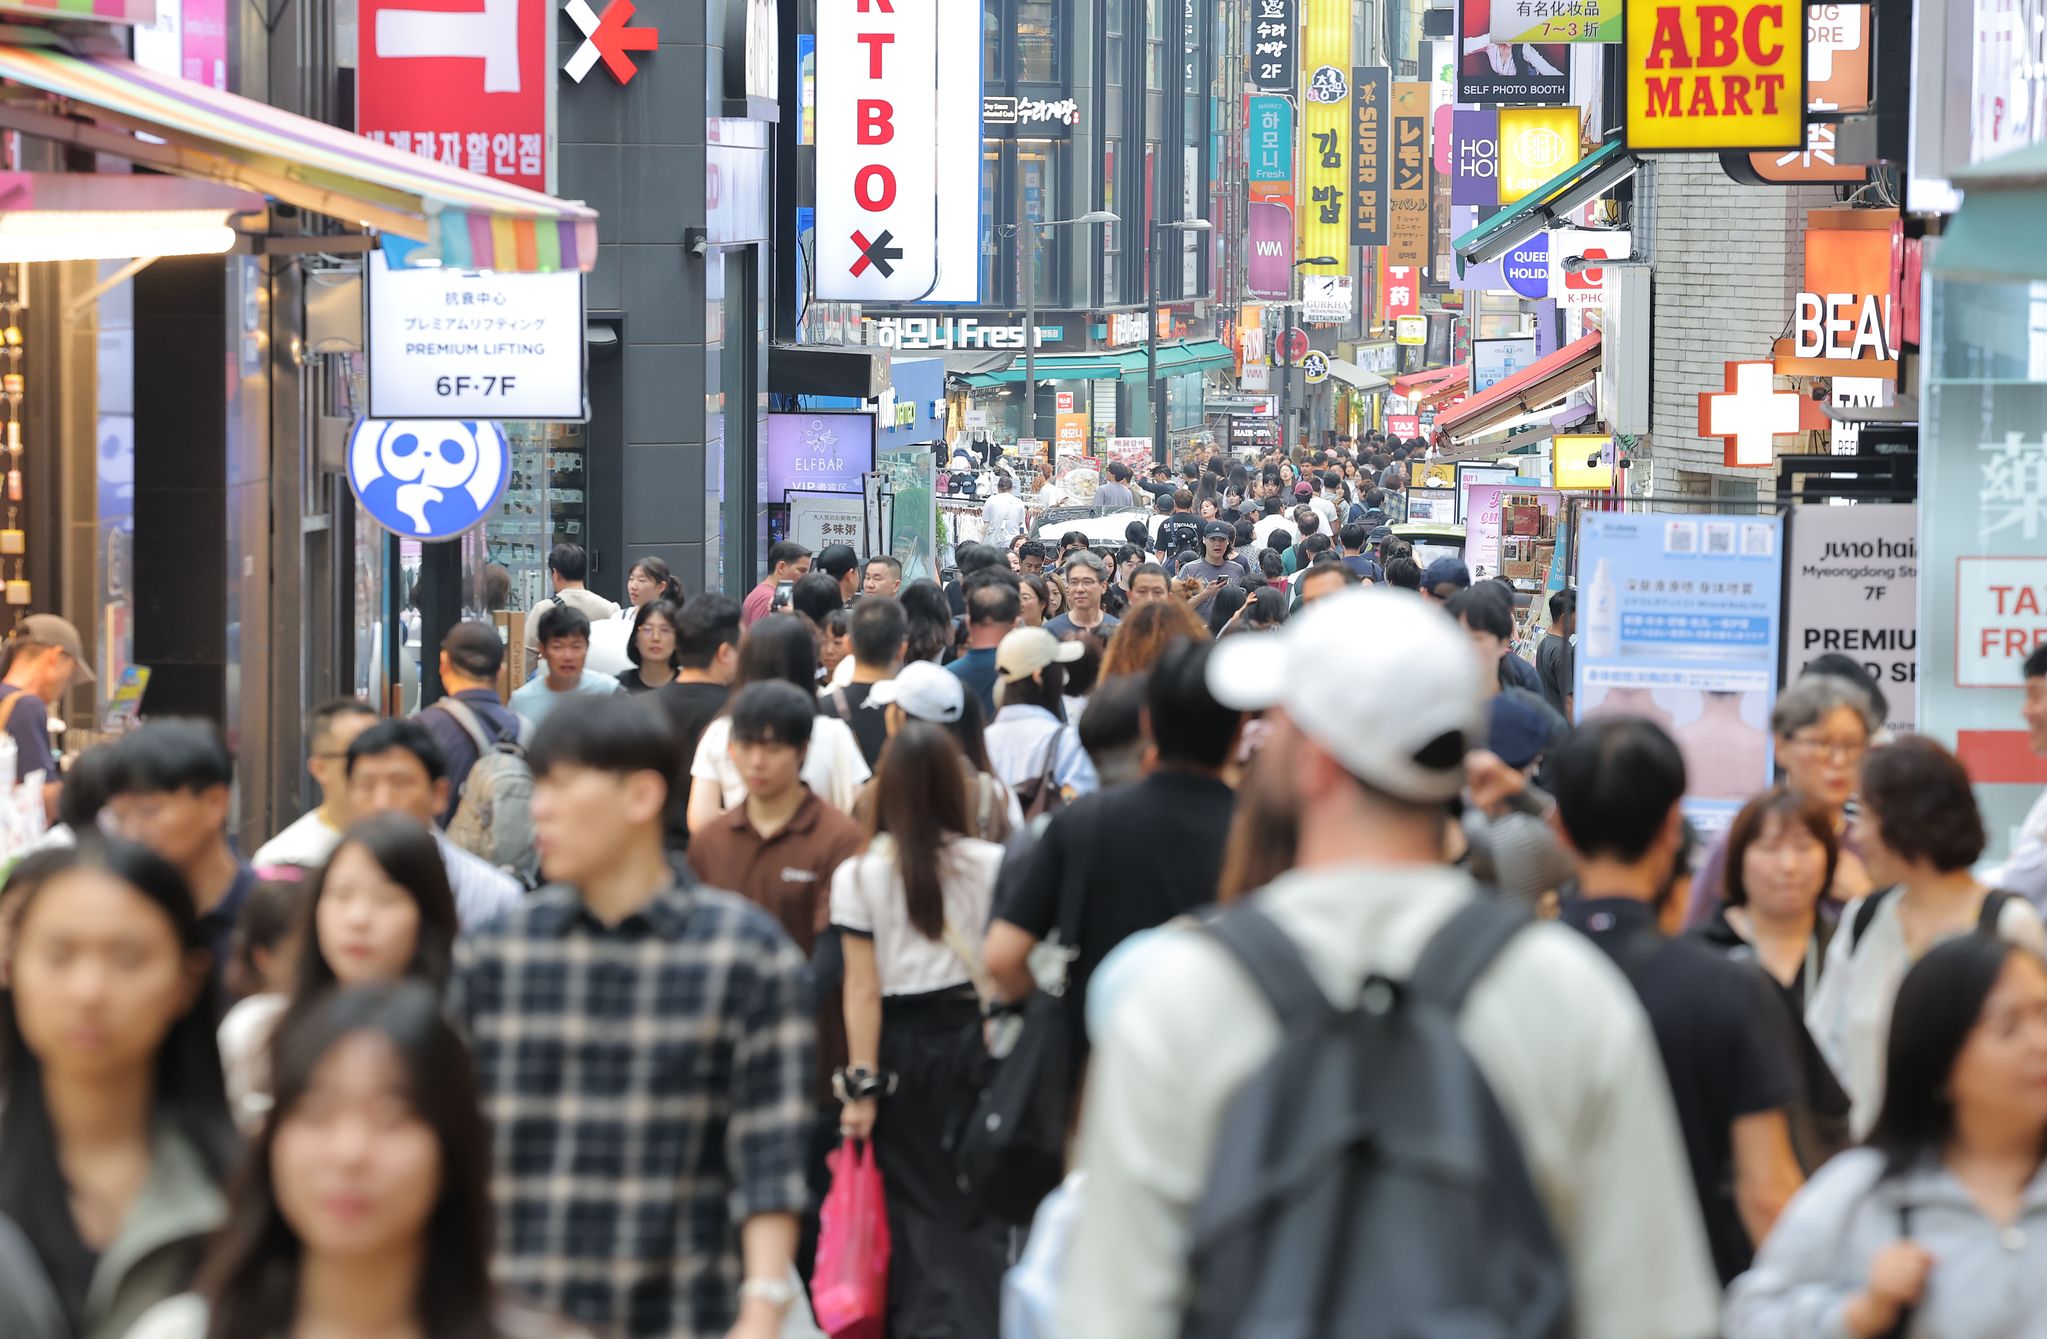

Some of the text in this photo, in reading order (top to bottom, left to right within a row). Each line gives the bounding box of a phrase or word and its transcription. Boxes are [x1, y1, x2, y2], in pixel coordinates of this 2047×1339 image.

[1516, 1, 1599, 16] 有名化妆品
[1584, 22, 1599, 37] 折
[1645, 5, 1784, 69] ABC
[1261, 63, 1282, 79] 2F
[1463, 85, 1490, 95] SELF
[1493, 85, 1527, 95] PHOTO
[1530, 85, 1565, 95] BOOTH
[1645, 75, 1784, 118] MART
[1262, 112, 1280, 168] 하모니
[1399, 120, 1422, 190] レモン
[1461, 139, 1497, 158] HO
[1256, 169, 1285, 178] Fresh
[1358, 106, 1377, 233] SUPER PET
[1460, 159, 1497, 177] HO
[1256, 240, 1283, 257] WM
[1306, 300, 1348, 309] GURKHA
[877, 317, 953, 350] 하모니
[405, 343, 545, 356] PREMIUM LIFTING
[1393, 422, 1415, 431] TAX
[795, 458, 844, 471] ELFBAR
[1463, 474, 1473, 482] BUY
[821, 522, 857, 536] 多味粥
[1802, 565, 1896, 580] Myeongdong
[1864, 585, 1887, 601] 7F
[1988, 585, 2047, 615] TA
